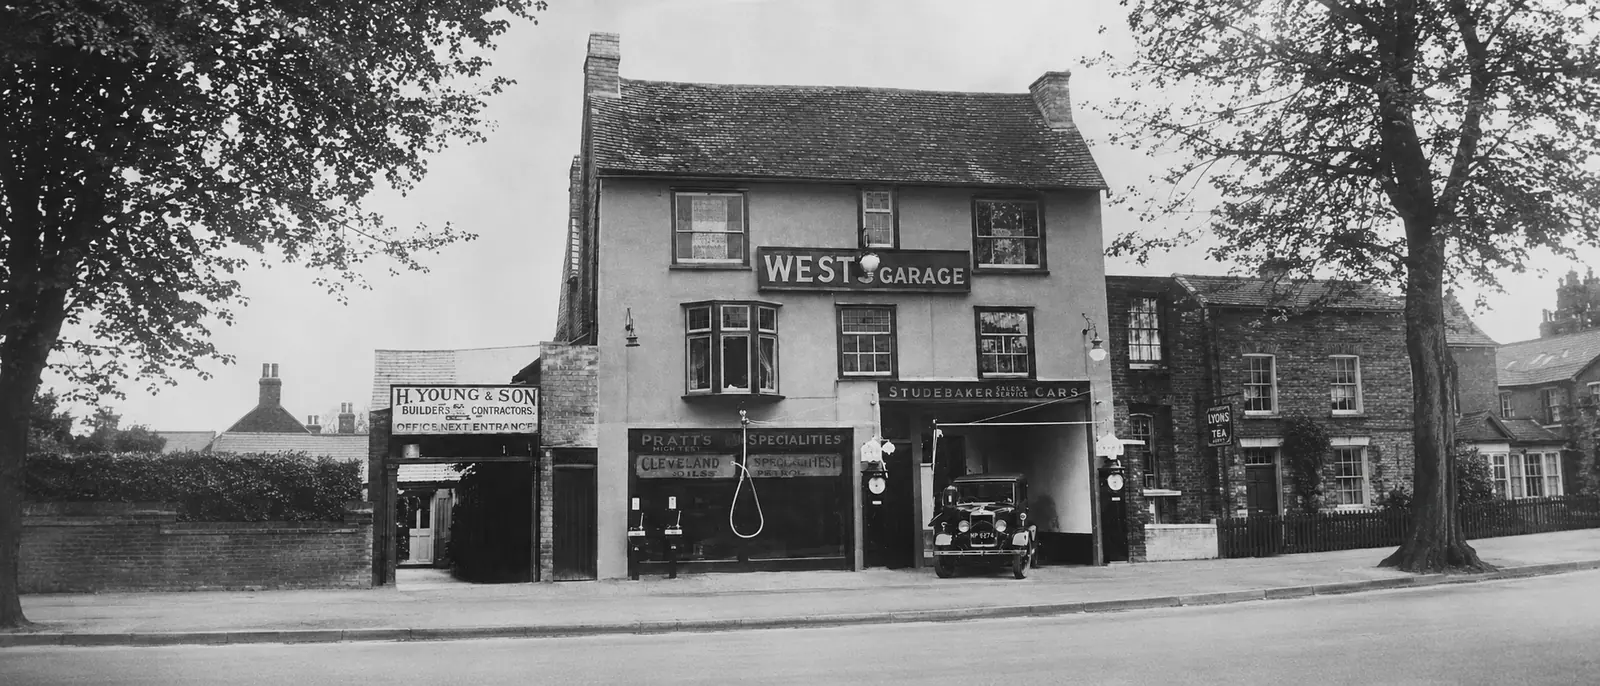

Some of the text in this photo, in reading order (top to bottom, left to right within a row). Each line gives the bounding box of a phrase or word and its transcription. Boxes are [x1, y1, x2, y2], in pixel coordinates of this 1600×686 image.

[879, 267, 964, 285] GARAGE
[416, 388, 480, 402] YOUNG
[484, 390, 493, 401] &
[498, 388, 537, 406] SON
[889, 386, 1079, 398] STUDEBAKER CARS
[402, 405, 451, 415] BUILDERS
[1207, 412, 1230, 424] LYONS
[473, 422, 533, 431] ENTRANCE
[1211, 428, 1227, 438] TEA
[641, 433, 712, 446] PRATT'S
[749, 434, 842, 446] SPECIALITIES
[641, 456, 720, 471] CLEVELAND
